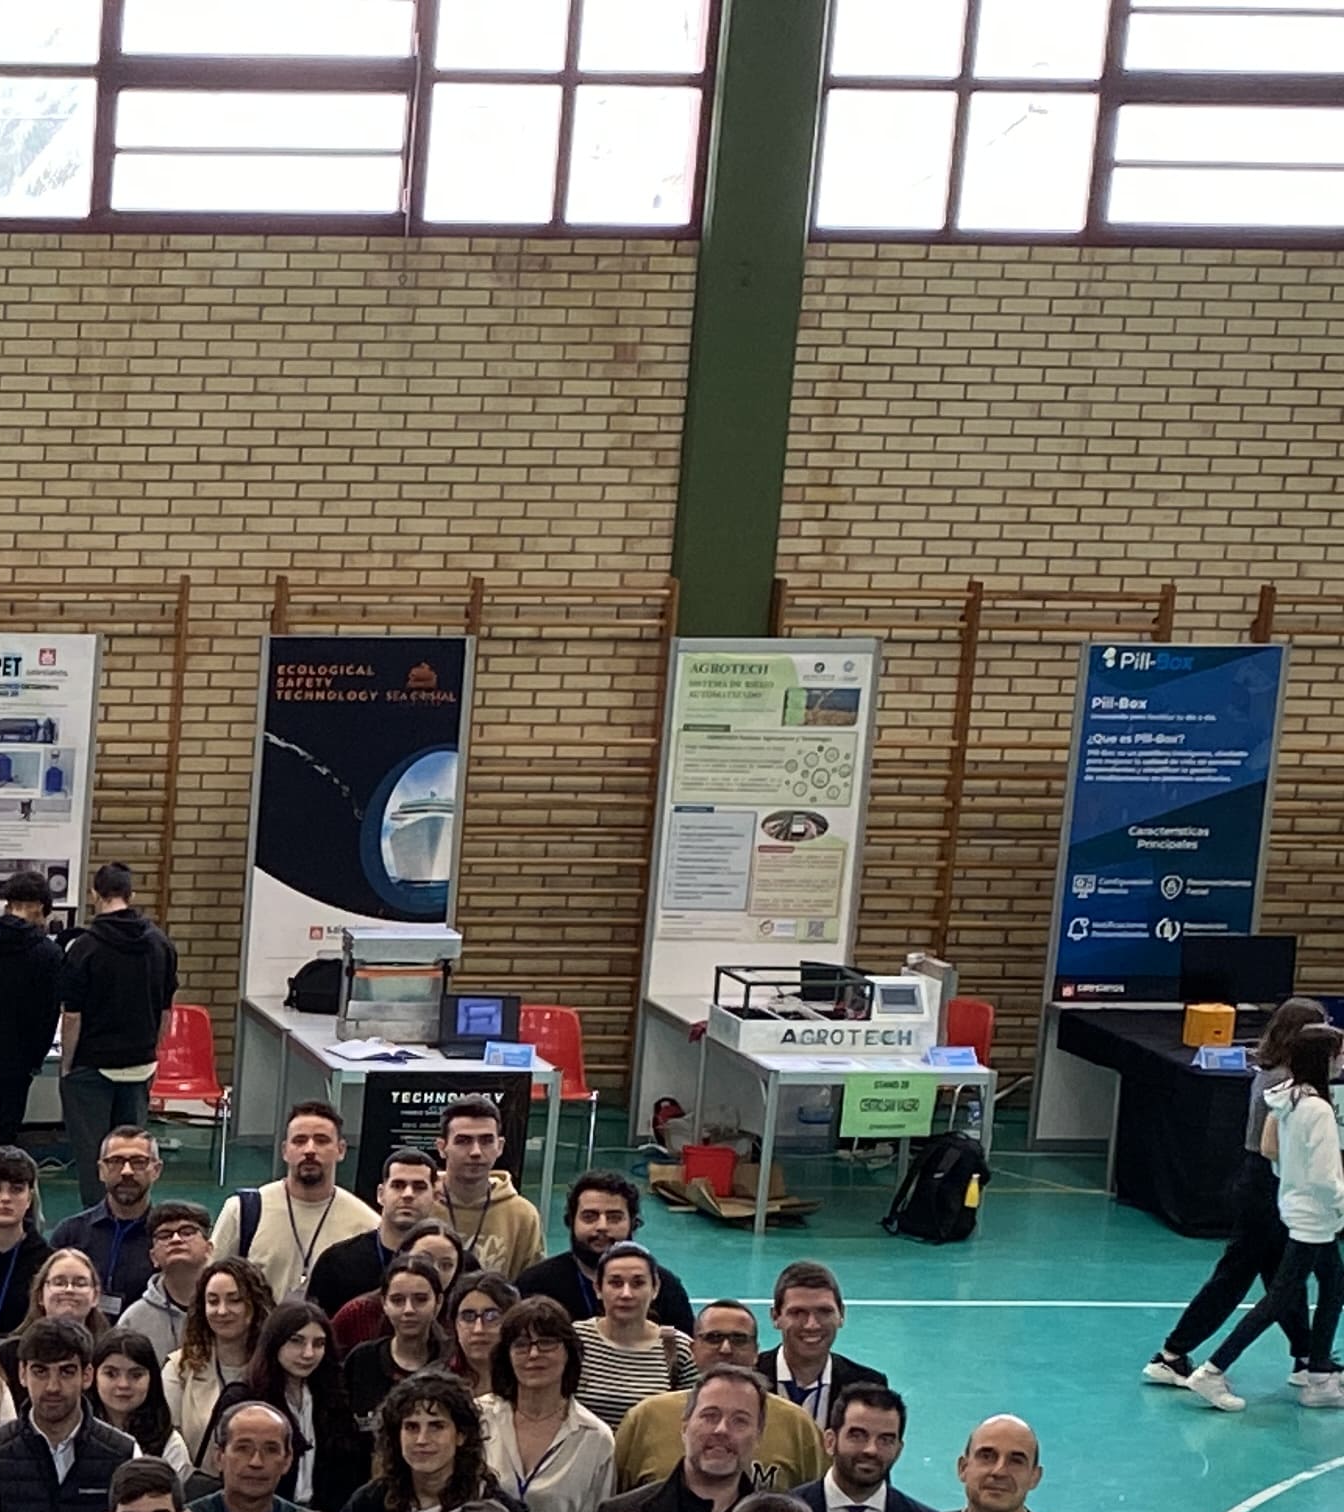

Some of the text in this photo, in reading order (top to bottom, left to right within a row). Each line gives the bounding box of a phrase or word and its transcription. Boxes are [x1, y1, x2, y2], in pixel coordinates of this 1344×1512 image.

[1120, 652, 1194, 670] Pill-Box
[277, 664, 375, 676] ECOLOGICAL
[690, 663, 769, 675] AGROTECH
[276, 677, 333, 688] SAFETY
[275, 690, 379, 701] TECHNOLOGY
[1091, 696, 1147, 709] Pill-Box
[1136, 839, 1198, 850] Principales
[780, 1029, 912, 1045] AGROTECH
[391, 1091, 505, 1104] TECHNOGY
